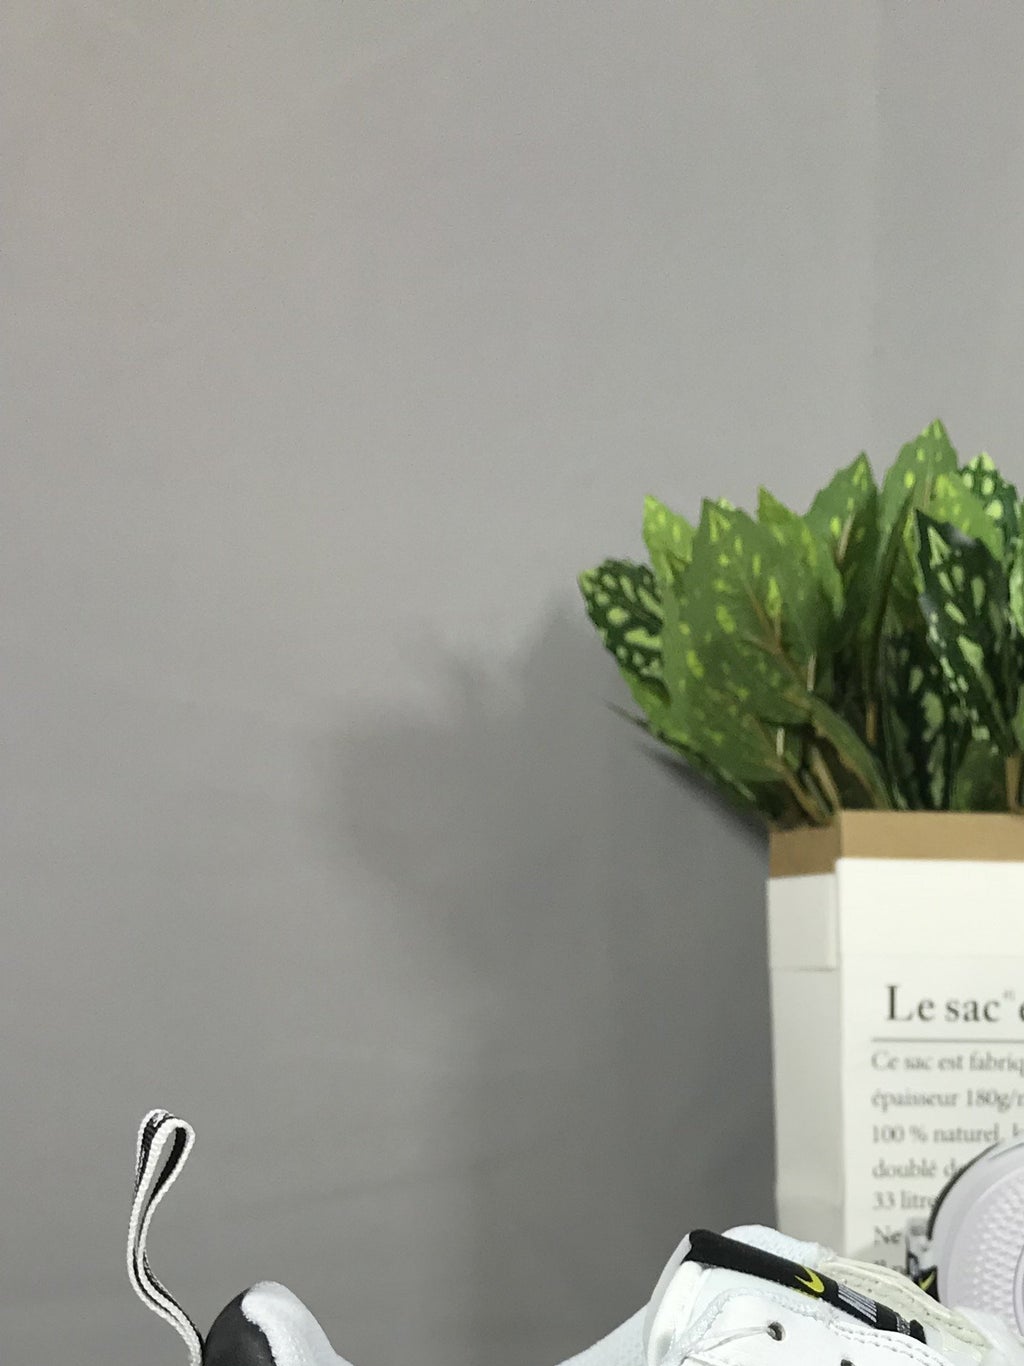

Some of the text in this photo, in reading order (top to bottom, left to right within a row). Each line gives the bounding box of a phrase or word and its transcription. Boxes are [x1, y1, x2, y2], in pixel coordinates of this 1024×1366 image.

[886, 984, 935, 1022] Le
[945, 998, 1000, 1023] sac
[871, 1051, 898, 1072] Ce
[903, 1055, 930, 1071] sac
[938, 1053, 963, 1071] est
[871, 1088, 959, 1113] épaisseur
[872, 1124, 905, 1143] 100
[909, 1125, 929, 1143] %
[872, 1158, 937, 1178] doublé
[872, 1190, 896, 1210] 33
